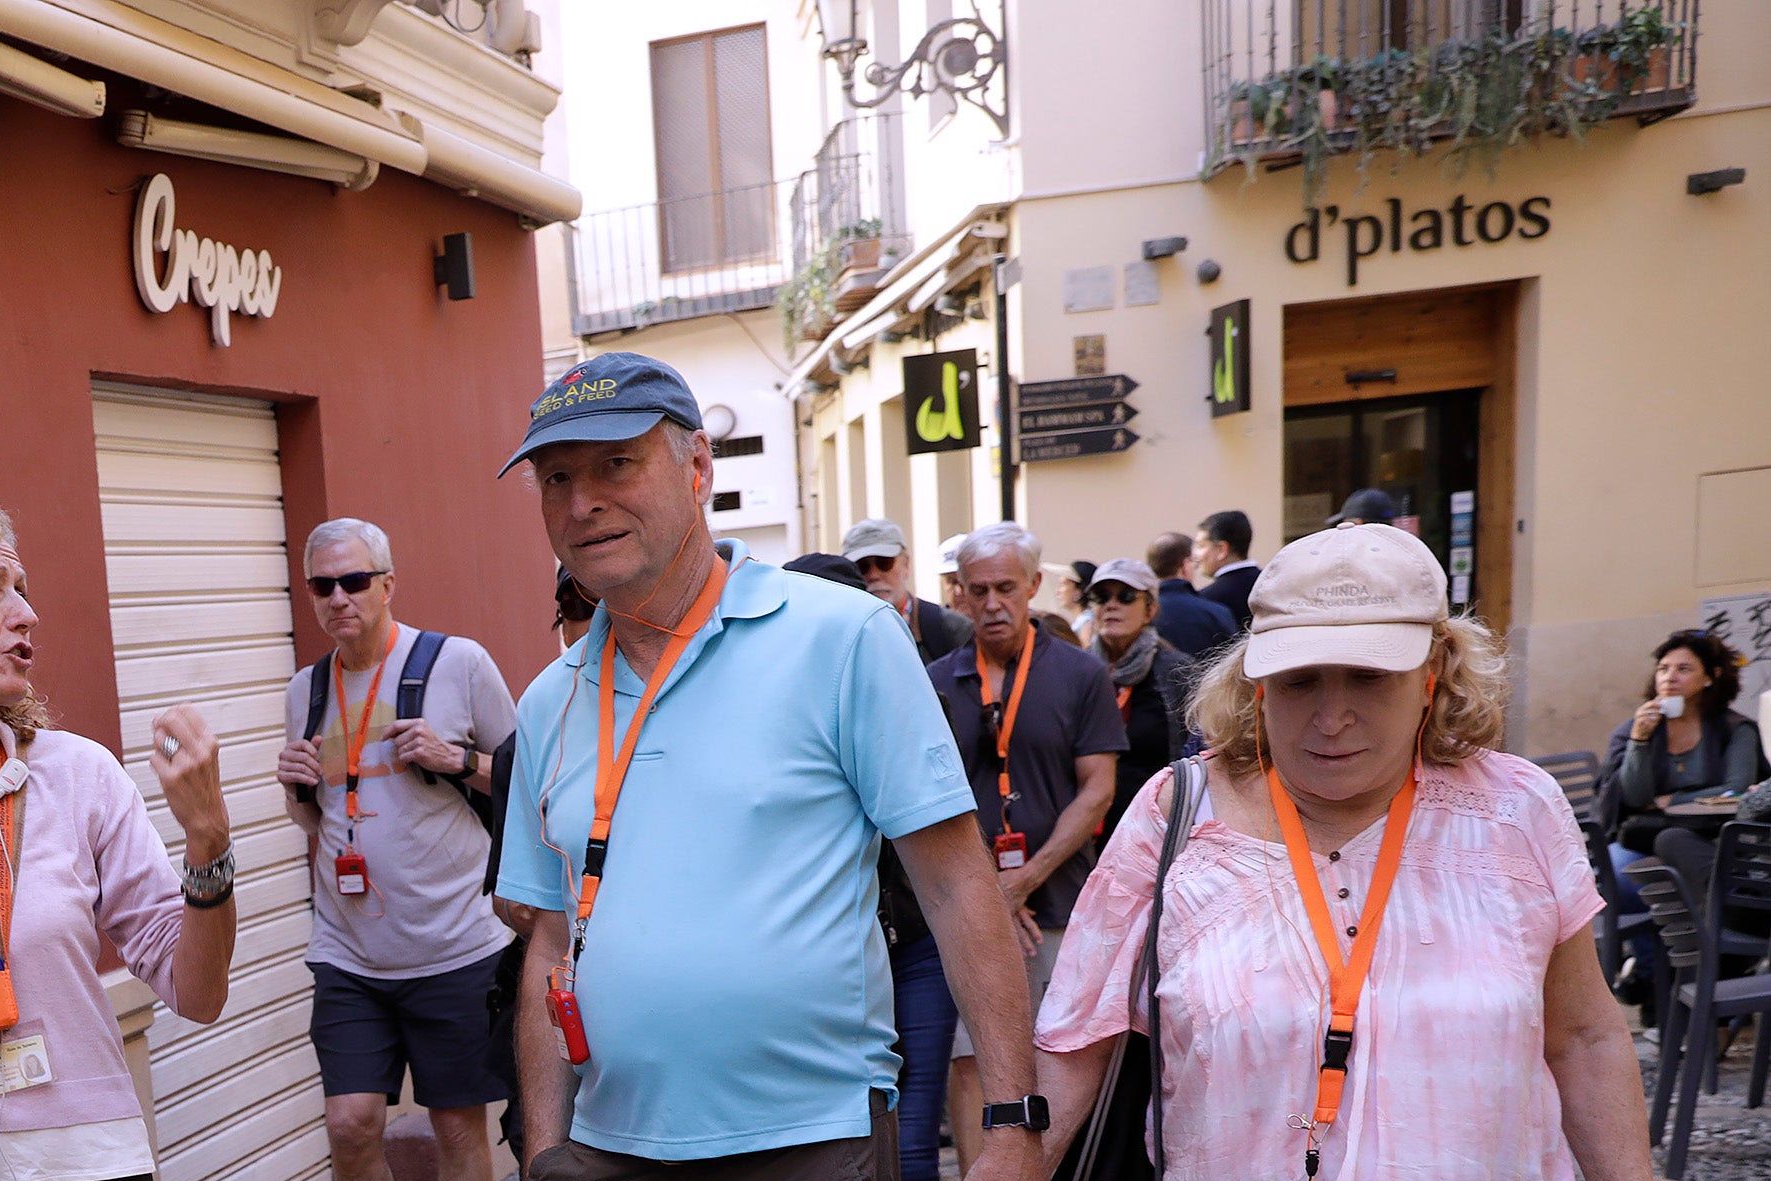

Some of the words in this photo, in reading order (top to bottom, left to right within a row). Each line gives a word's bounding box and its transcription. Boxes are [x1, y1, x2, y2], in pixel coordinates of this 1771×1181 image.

[134, 173, 281, 347] Crepes
[1285, 194, 1551, 286] d'platos
[578, 390, 616, 403] FEED
[1316, 584, 1369, 598] PHINDA
